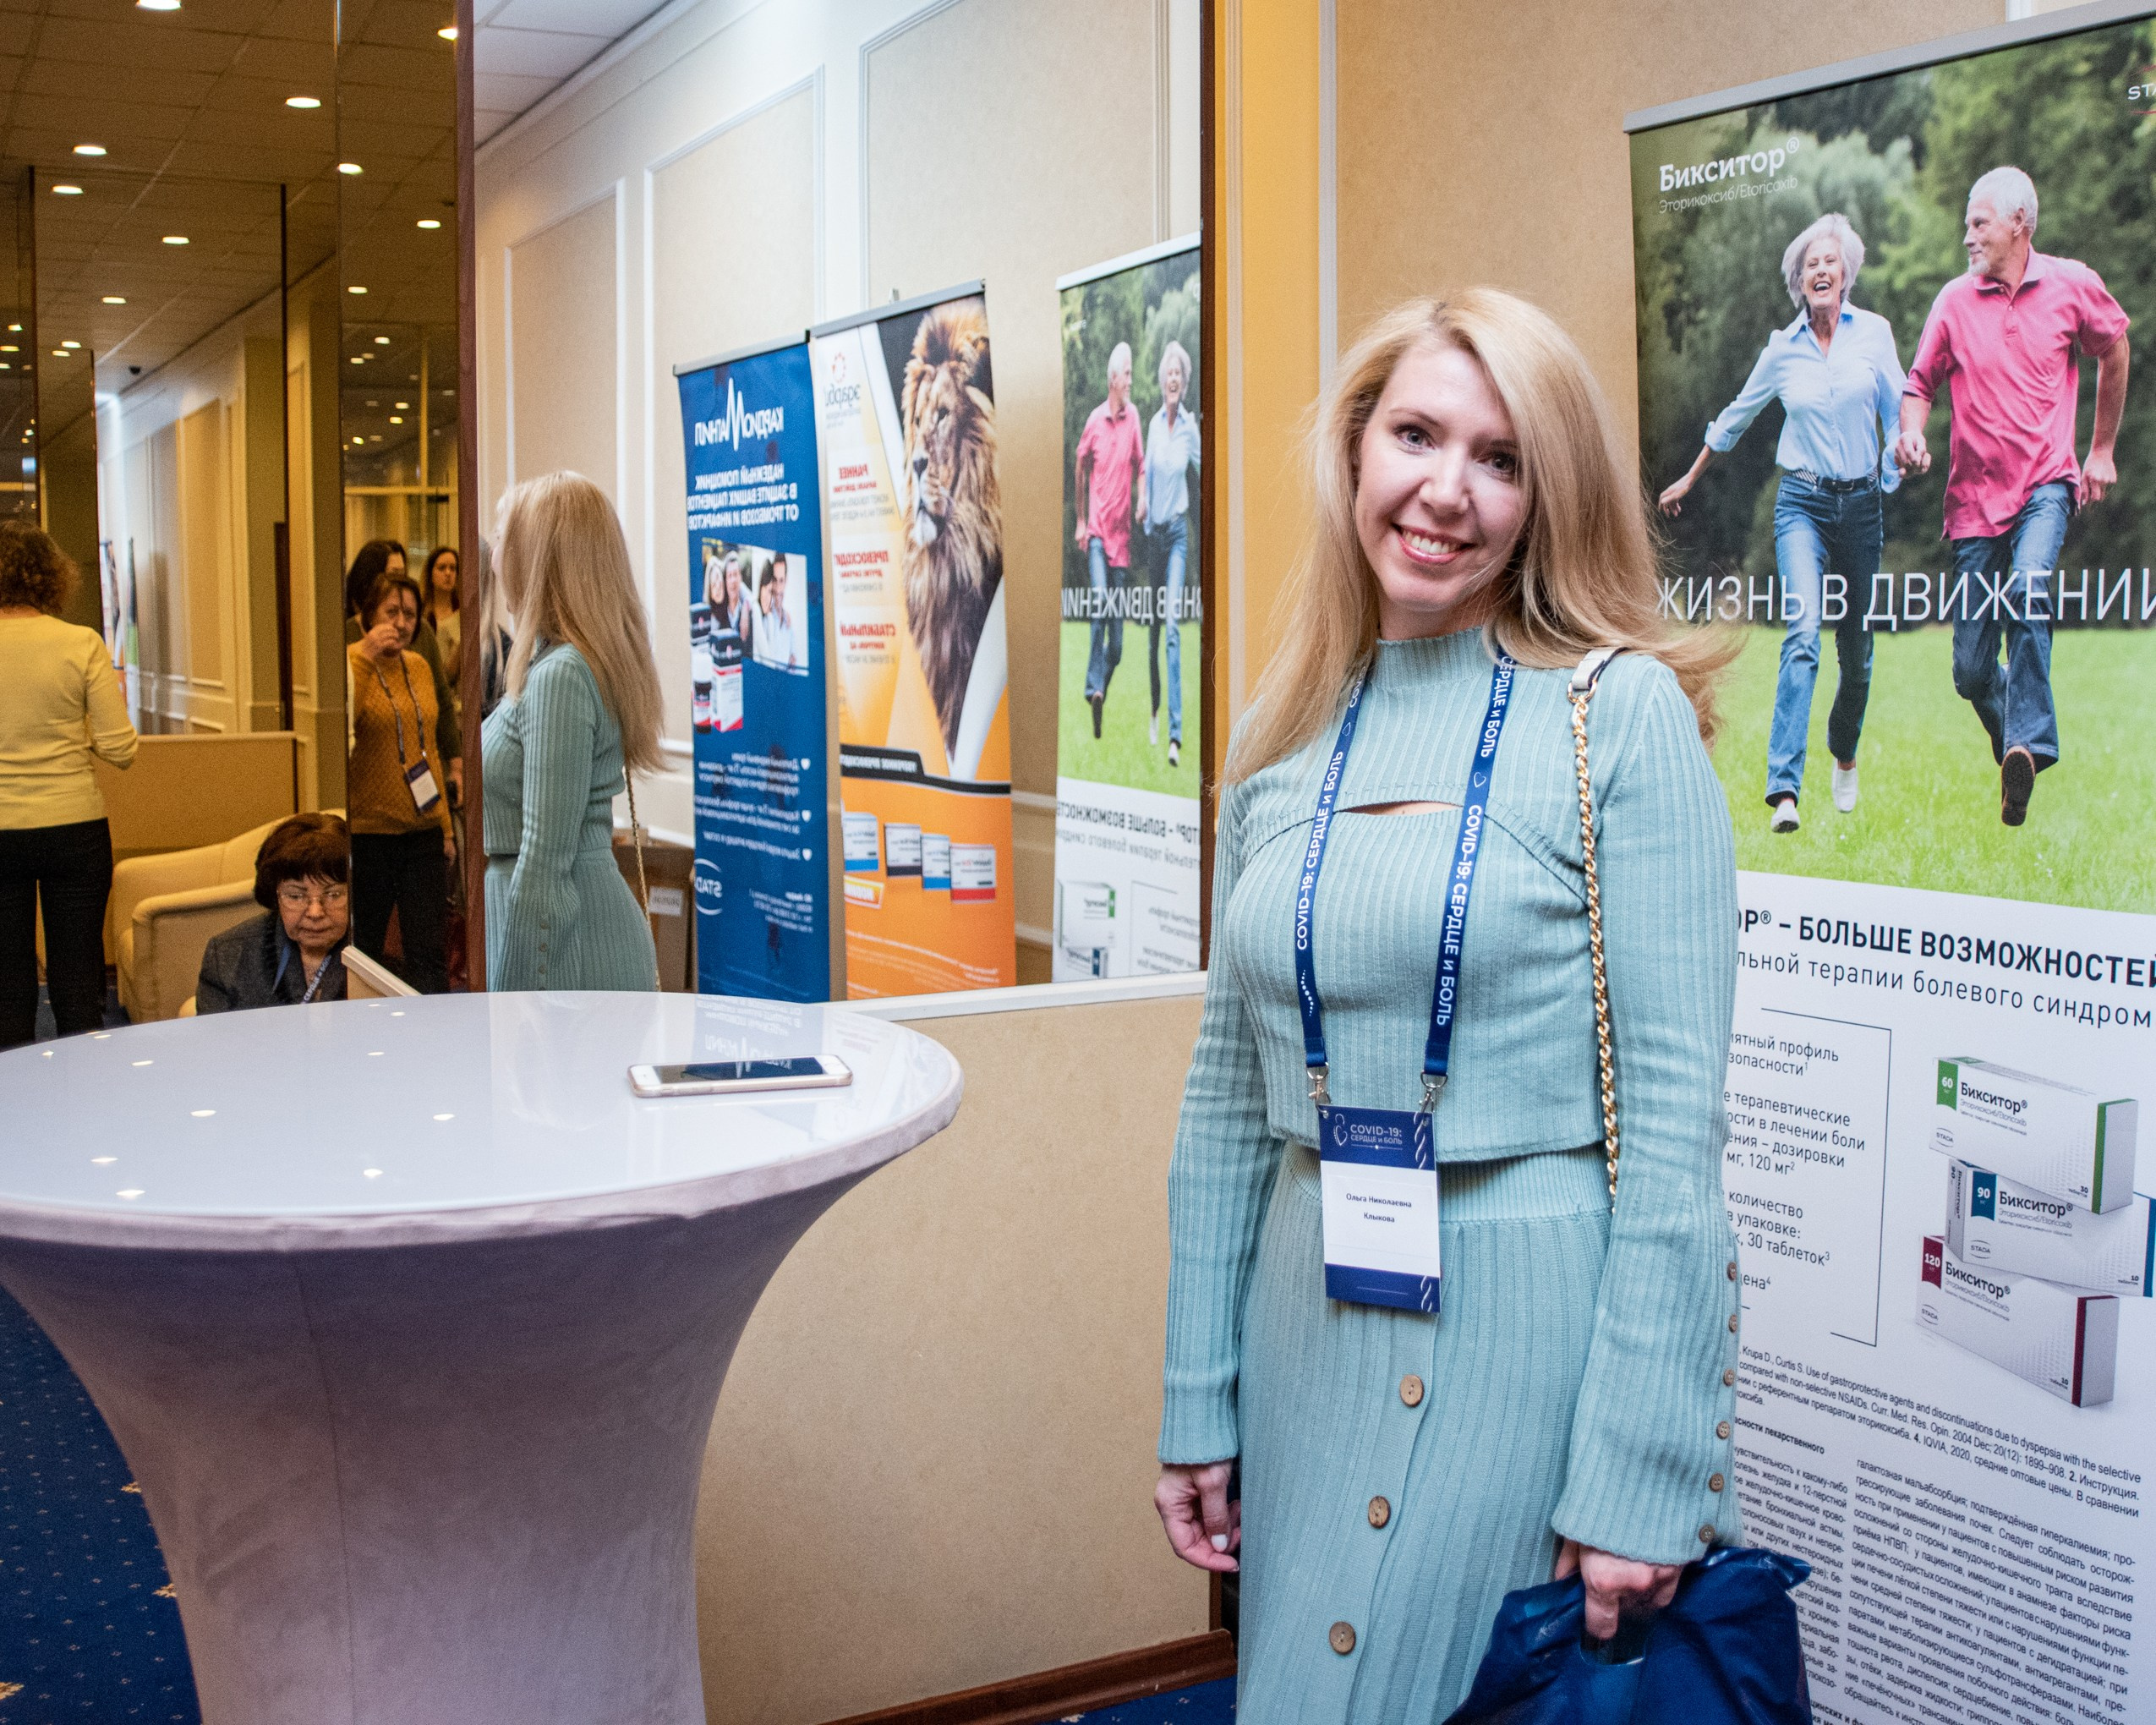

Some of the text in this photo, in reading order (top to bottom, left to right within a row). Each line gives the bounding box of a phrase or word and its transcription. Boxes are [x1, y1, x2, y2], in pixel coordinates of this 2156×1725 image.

[1660, 137, 1799, 192] Бикситор®
[1659, 175, 1798, 214] Эторикоксиб/Etoricoxib
[1655, 575, 1806, 621] ЖИЗНЬ
[1821, 574, 1848, 621] В
[1480, 719, 1501, 758] БОЛЬ
[1324, 751, 1343, 791] БОЛЬ
[1322, 794, 1332, 805] и
[1306, 807, 1329, 869] СЕРДЦЕ
[1440, 883, 1466, 956] СЕРДЦЕ
[1799, 916, 1912, 954] БОЛЬШЕ
[1442, 960, 1454, 971] и
[1808, 961, 1902, 989] терапии
[1913, 970, 2022, 1008] болевого
[1436, 975, 1455, 1026] БОЛЬ
[1779, 1041, 1838, 1061] профиль
[1941, 1076, 1953, 1088] 60
[1734, 1092, 1850, 1126] терапевтические
[1961, 1082, 2027, 1115] Бикситор®
[1350, 1134, 1377, 1143] СЕРДЦЕ
[1383, 1136, 1403, 1145] БОЛЬ
[1759, 1118, 1766, 1129] в
[1770, 1120, 1827, 1142] лечении
[1831, 1130, 1864, 1150] боли
[1726, 1152, 1743, 1167] мг,
[1749, 1153, 1770, 1171] 120
[1772, 1142, 1844, 1167] дозировки
[1346, 1193, 1412, 1208] Ольга Николаевна
[1729, 1191, 1803, 1218] количество
[1977, 1186, 1990, 1199] 90
[1999, 1191, 2073, 1218] Бикситор®
[2080, 1186, 2088, 1194] 30
[1363, 1213, 1395, 1223] Клыкова
[1737, 1213, 1800, 1239] упаковке:
[1747, 1231, 1762, 1249] 30
[1971, 1245, 1991, 1253] STADA
[1924, 1252, 1940, 1268] 120
[1945, 1262, 2011, 1300] Бикситор®
[1922, 1308, 1939, 1321] STADA
[1743, 1345, 1763, 1360] Krupa
[1775, 1355, 1796, 1371] Curtis
[1797, 1362, 1804, 1373] S.
[1806, 1366, 1820, 1378] Use
[1821, 1372, 1829, 1381] of
[1830, 1375, 1888, 1400] gastroprotective
[1889, 1394, 1914, 1409] agents
[1915, 1403, 1930, 1415] and
[1931, 1406, 1993, 1436] discontinuations
[1995, 1428, 2010, 1442] due
[2011, 1433, 2019, 1445] to
[2020, 1437, 2061, 1460] dyspepsia
[2062, 1453, 2080, 1466] with
[2082, 1458, 2096, 1471] the
[2098, 1465, 2141, 1483] selective
[1738, 1361, 1773, 1378] compared
[1774, 1372, 1788, 1383] with
[1790, 1377, 1836, 1399] non-selective
[1837, 1391, 1867, 1410] NSAIDs.
[1871, 1401, 1888, 1416] Curr.
[1891, 1408, 1908, 1423] Med.
[1911, 1415, 1928, 1430] Res.
[1930, 1421, 1950, 1438] Opin.
[1952, 1429, 1972, 1444] 2004
[1973, 1436, 1992, 1454] Dec;
[1993, 1443, 2022, 1464] 20(12):
[2069, 1470, 2077, 1482] 2.
[2079, 1473, 2139, 1500] Инструкция.
[1765, 1427, 1825, 1454] лекарственного
[1758, 1382, 1809, 1405] референтным
[1811, 1399, 1856, 1421] препаратом
[1858, 1415, 1911, 1440] эторикоксиба.
[1923, 1435, 1948, 1454] IQVIA,
[1950, 1444, 1972, 1463] 2020,
[1974, 1455, 2008, 1475] средние
[2010, 1469, 2046, 1488] оптовые
[2048, 1482, 2073, 1498] цены.
[2077, 1489, 2083, 1501] В
[2085, 1495, 2138, 1518] сравнении
[1857, 1459, 2136, 1565] галактозная мальабсорбция; подтверждённая гиперкалиемия; про-
[1856, 1476, 2134, 1584] грессирующие заболевания почек. Следует соблюдать осторож-
